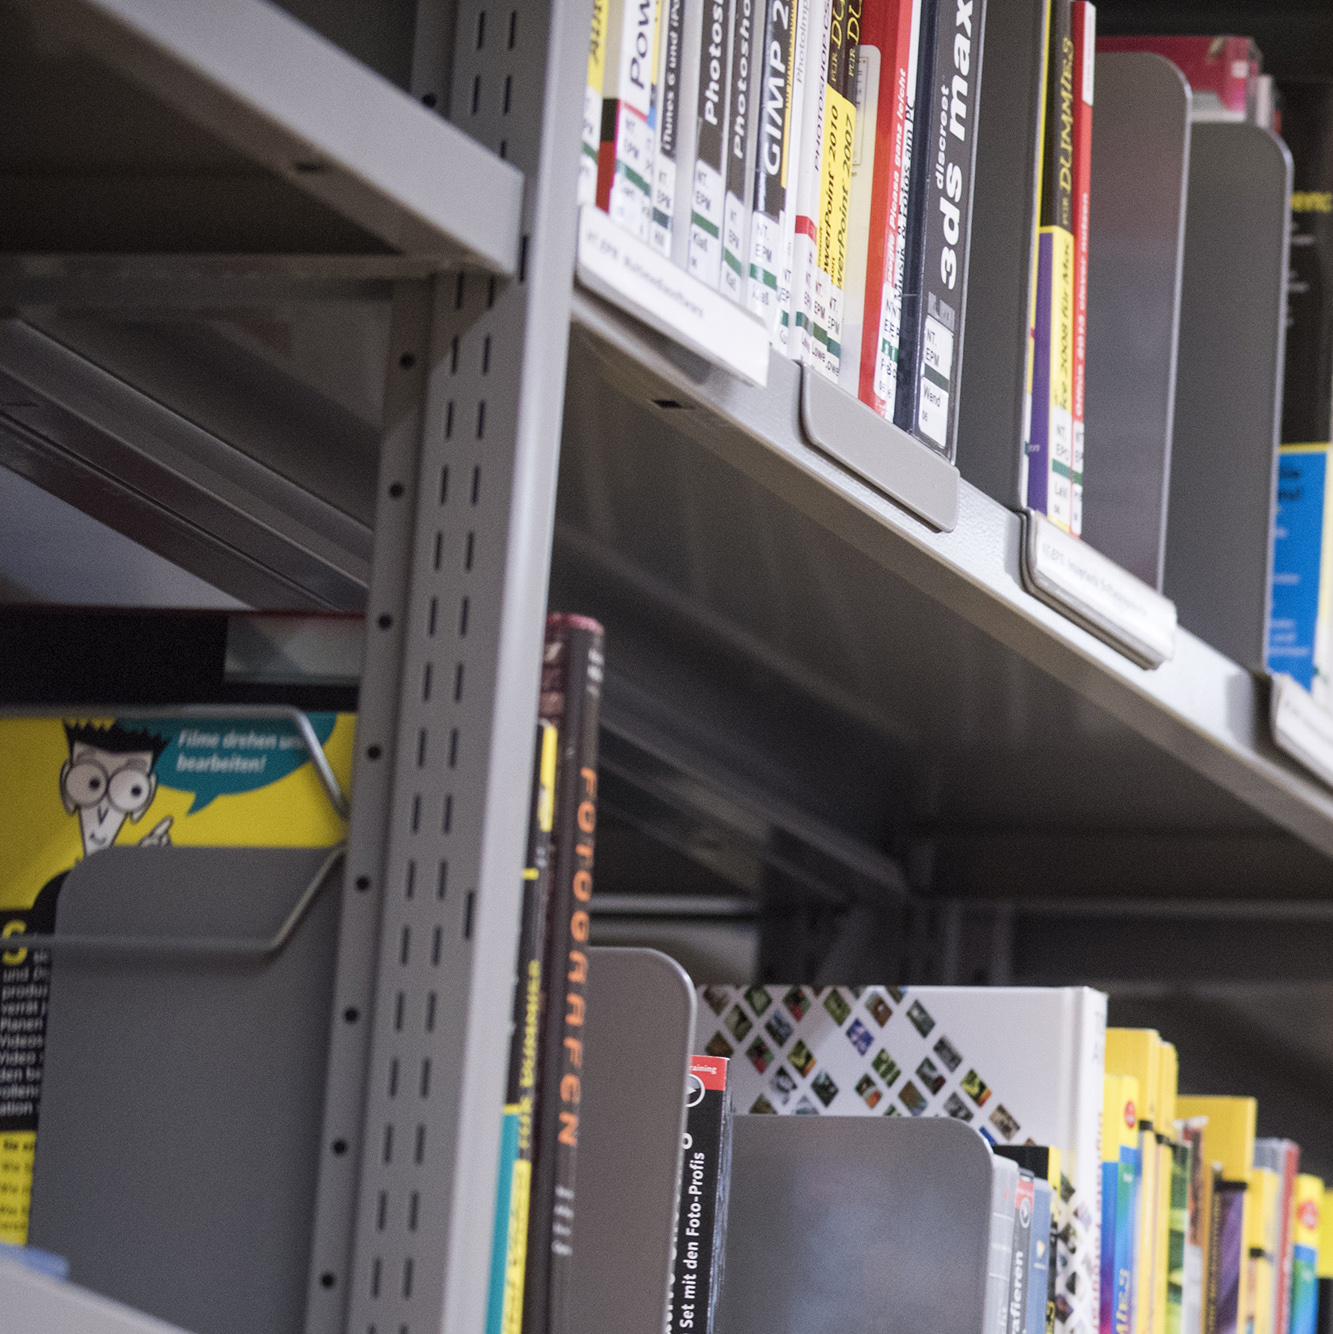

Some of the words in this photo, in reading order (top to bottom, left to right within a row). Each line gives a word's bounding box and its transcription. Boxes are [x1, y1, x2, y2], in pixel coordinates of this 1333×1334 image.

[668, 31, 679, 69] und
[704, 0, 725, 127] Photos
[949, 0, 974, 142] max
[662, 91, 676, 151] iTunes
[762, 40, 788, 176] GIMP
[898, 67, 908, 120] leicht
[1058, 37, 1074, 194] DUMMIES
[829, 106, 841, 163] 2010
[894, 123, 905, 169] ganz
[935, 84, 950, 191] discreet
[888, 169, 902, 230] Picasa
[939, 162, 962, 290] 3ds
[885, 233, 899, 284] oogle
[922, 383, 941, 408] Wend
[175, 752, 267, 773] bearbeiten!
[177, 729, 220, 749] Filme
[221, 729, 277, 751] drehen
[685, 1152, 706, 1237] Foto-Profis
[683, 1241, 700, 1269] den
[682, 1272, 698, 1300] mit
[679, 1303, 696, 1328] Set
